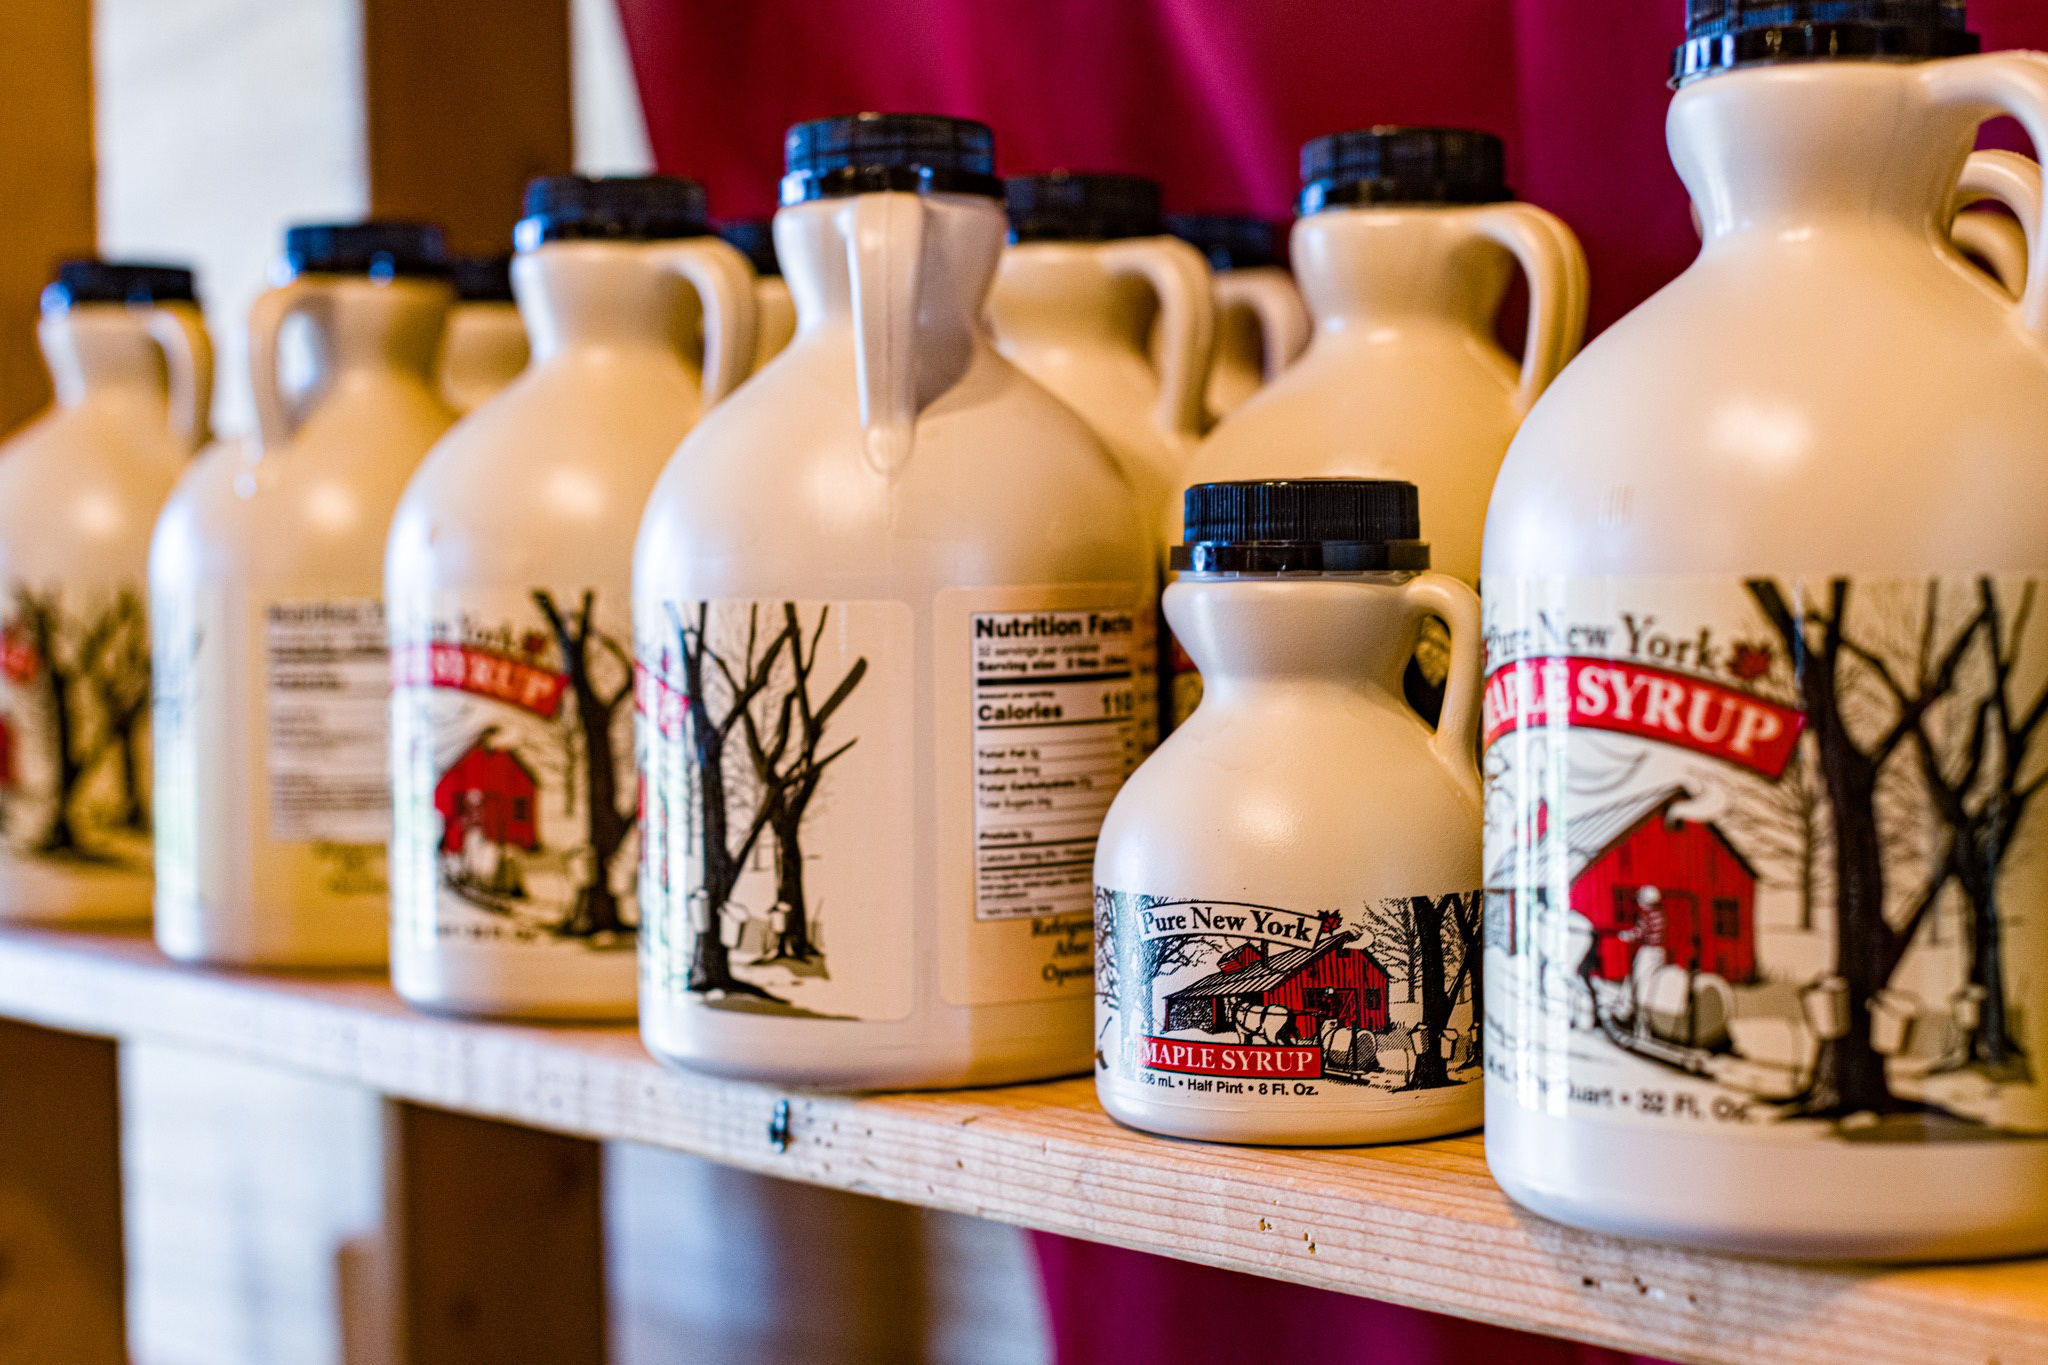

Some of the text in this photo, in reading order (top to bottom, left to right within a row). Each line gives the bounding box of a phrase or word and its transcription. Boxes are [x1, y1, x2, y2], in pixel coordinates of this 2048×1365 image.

[976, 616, 1082, 638] Nutrition
[1620, 611, 1719, 670] York
[978, 702, 1063, 722] Calories
[1576, 665, 1784, 754] SYRUP
[1142, 906, 1314, 942] Pure New York
[1141, 1042, 1313, 1072] MAPLE SYRUP
[1157, 1075, 1176, 1088] mL
[1187, 1078, 1214, 1092] Half
[1216, 1081, 1244, 1094] Pint
[1258, 1082, 1268, 1095] 8
[1272, 1083, 1289, 1096] Fl.
[1293, 1083, 1320, 1096] Oz.
[1637, 1088, 1665, 1115] 32
